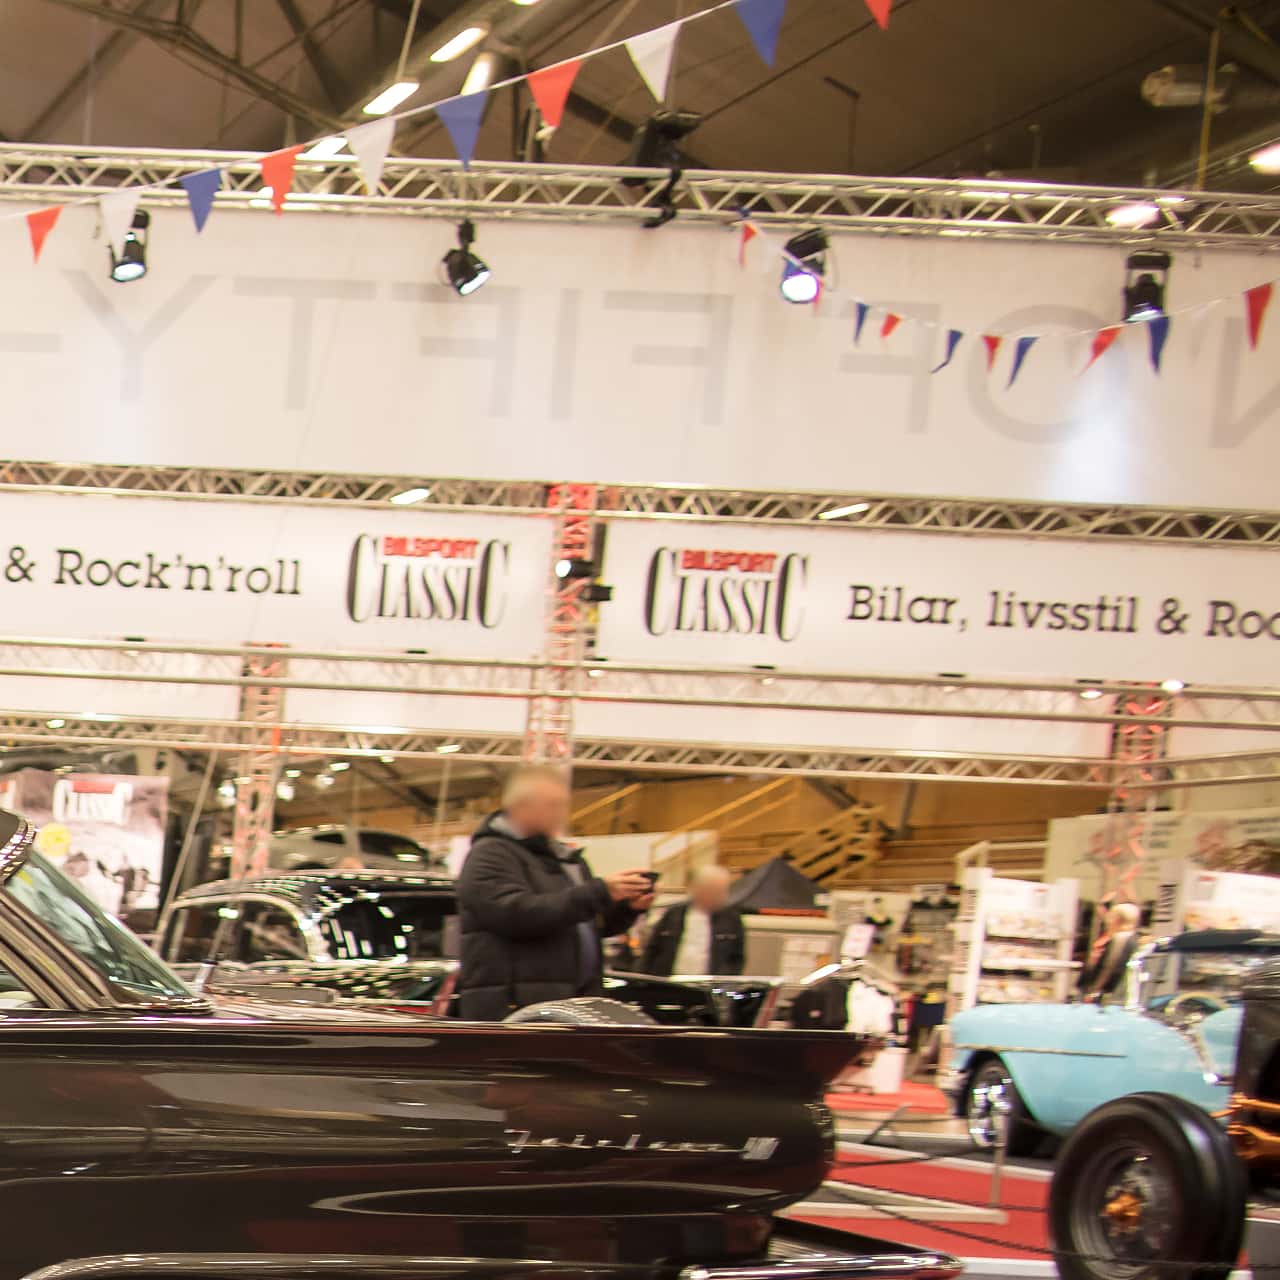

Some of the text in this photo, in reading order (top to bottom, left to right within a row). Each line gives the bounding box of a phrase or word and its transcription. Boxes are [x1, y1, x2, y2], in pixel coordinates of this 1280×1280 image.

[3, 545, 36, 583] &
[52, 547, 301, 596] Rock'n'roll
[383, 536, 480, 561] BILSPORT
[680, 549, 778, 574] BILSPORT
[345, 532, 510, 629] CLASSIC
[643, 546, 811, 642] CLASSIC
[846, 584, 967, 632] Bilar,
[986, 590, 1139, 633] livsstil
[1155, 597, 1190, 635] &
